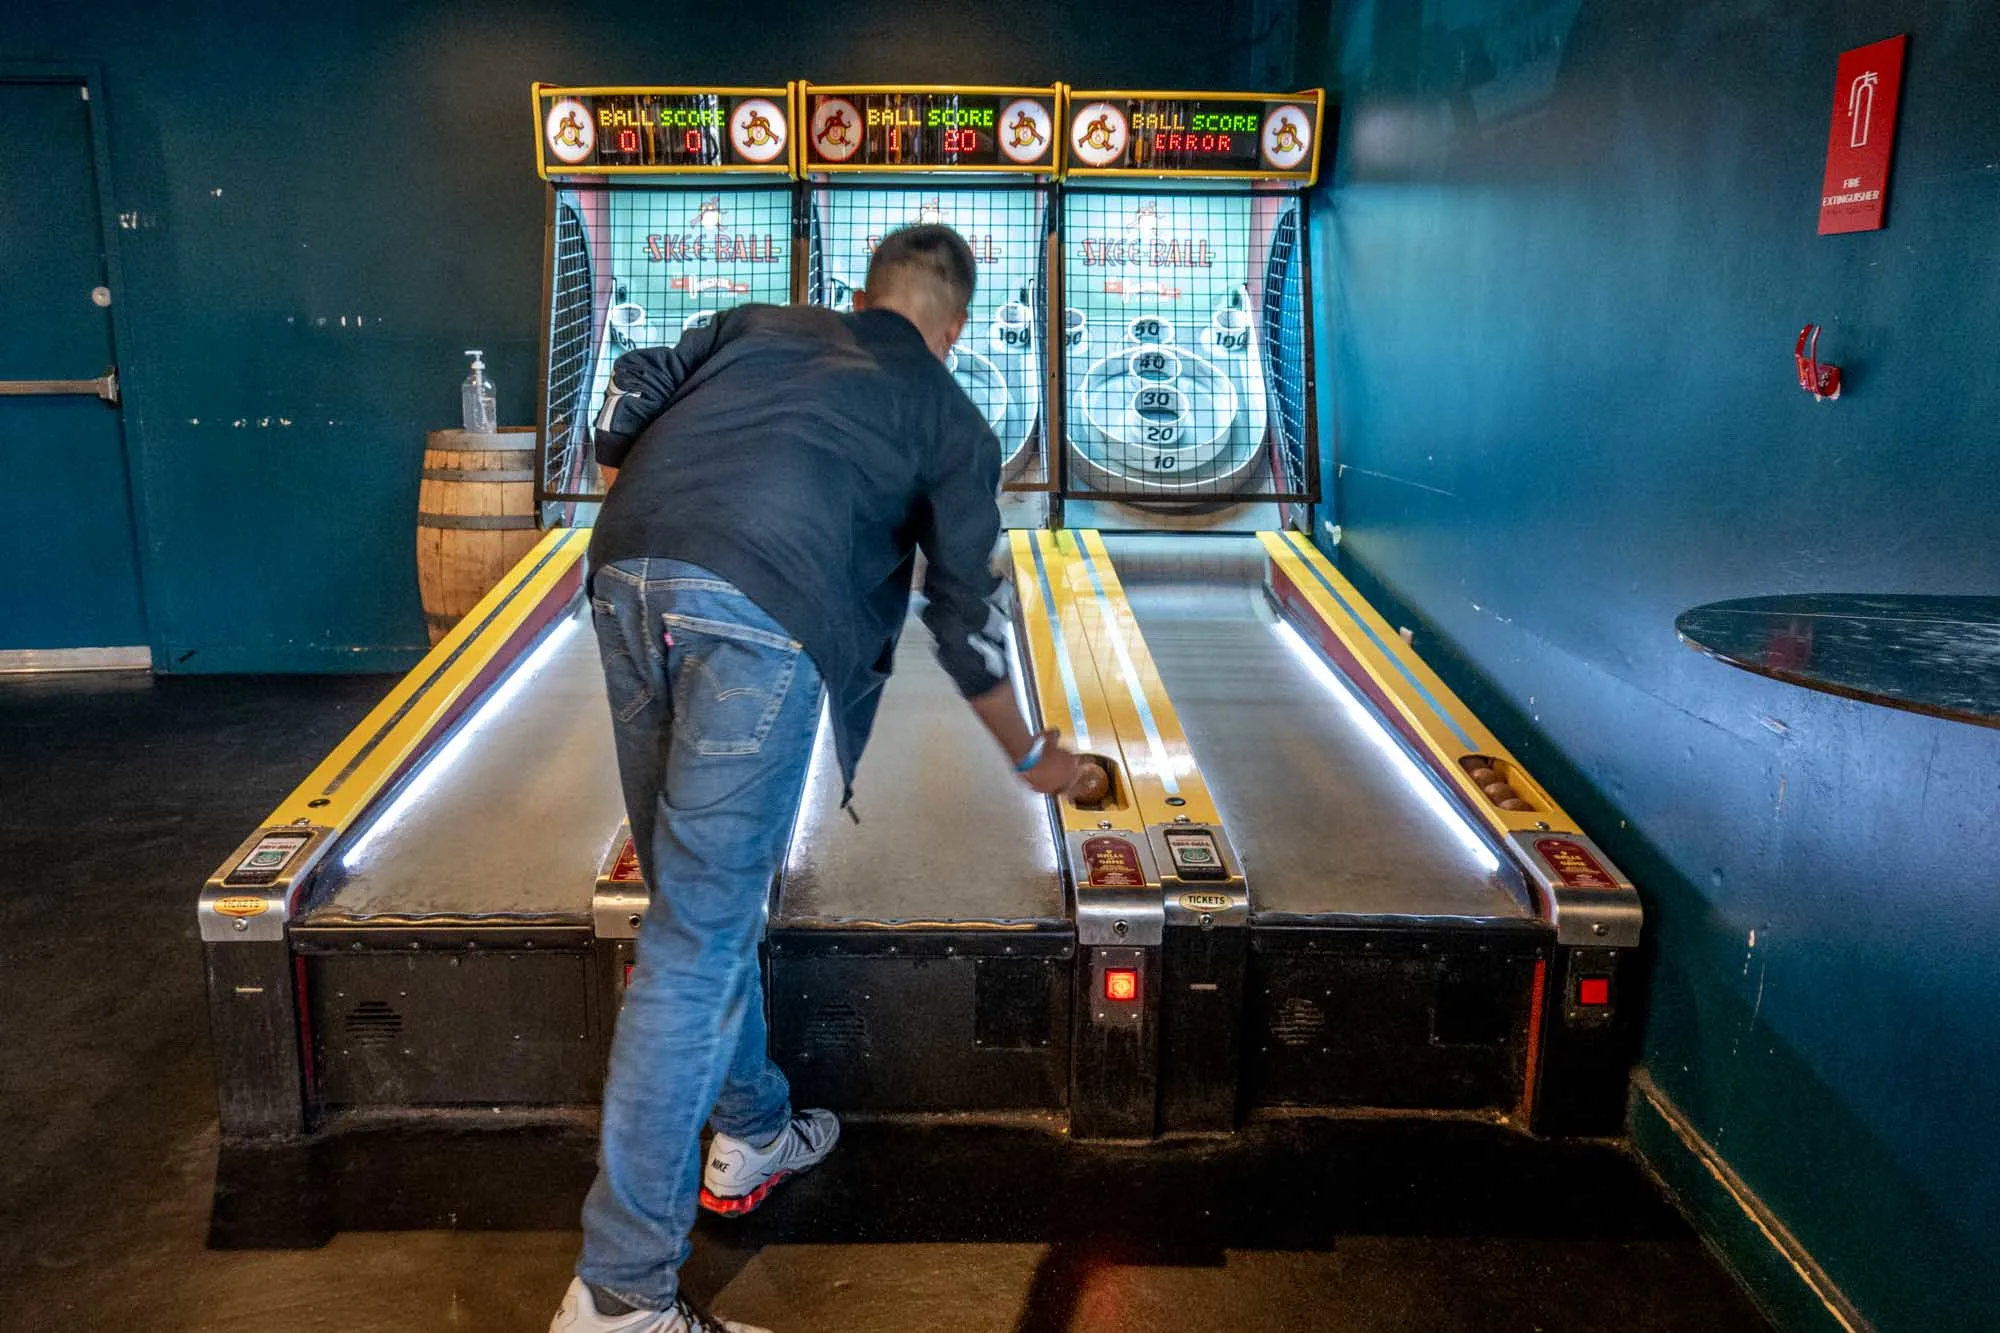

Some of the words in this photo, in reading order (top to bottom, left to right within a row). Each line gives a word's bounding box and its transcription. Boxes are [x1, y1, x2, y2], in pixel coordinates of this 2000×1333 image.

[599, 109, 654, 126] BALL
[660, 109, 725, 126] SCORE
[867, 109, 921, 126] BALL
[928, 109, 993, 126] SCORE
[1132, 113, 1185, 130] BALL
[1192, 114, 1257, 131] SCORE
[620, 129, 636, 151] 0
[686, 129, 702, 151] 0
[890, 129, 900, 151] 1
[944, 129, 976, 151] 20
[1155, 133, 1231, 151] ERROR
[1843, 176, 1861, 189] FIRE
[1822, 190, 1880, 207] EXTINGUISHER
[648, 233, 708, 263] SKEE
[715, 233, 780, 263] BALL
[1081, 238, 1141, 267] SKEE
[1149, 238, 1213, 268] BALL
[1135, 320, 1160, 337] 50
[1139, 355, 1165, 370] 40
[1143, 392, 1170, 406] 30
[1147, 426, 1173, 442] 20
[1153, 455, 1175, 470] 10
[1187, 895, 1226, 905] TICKETS
[711, 1157, 730, 1173] NIKE
